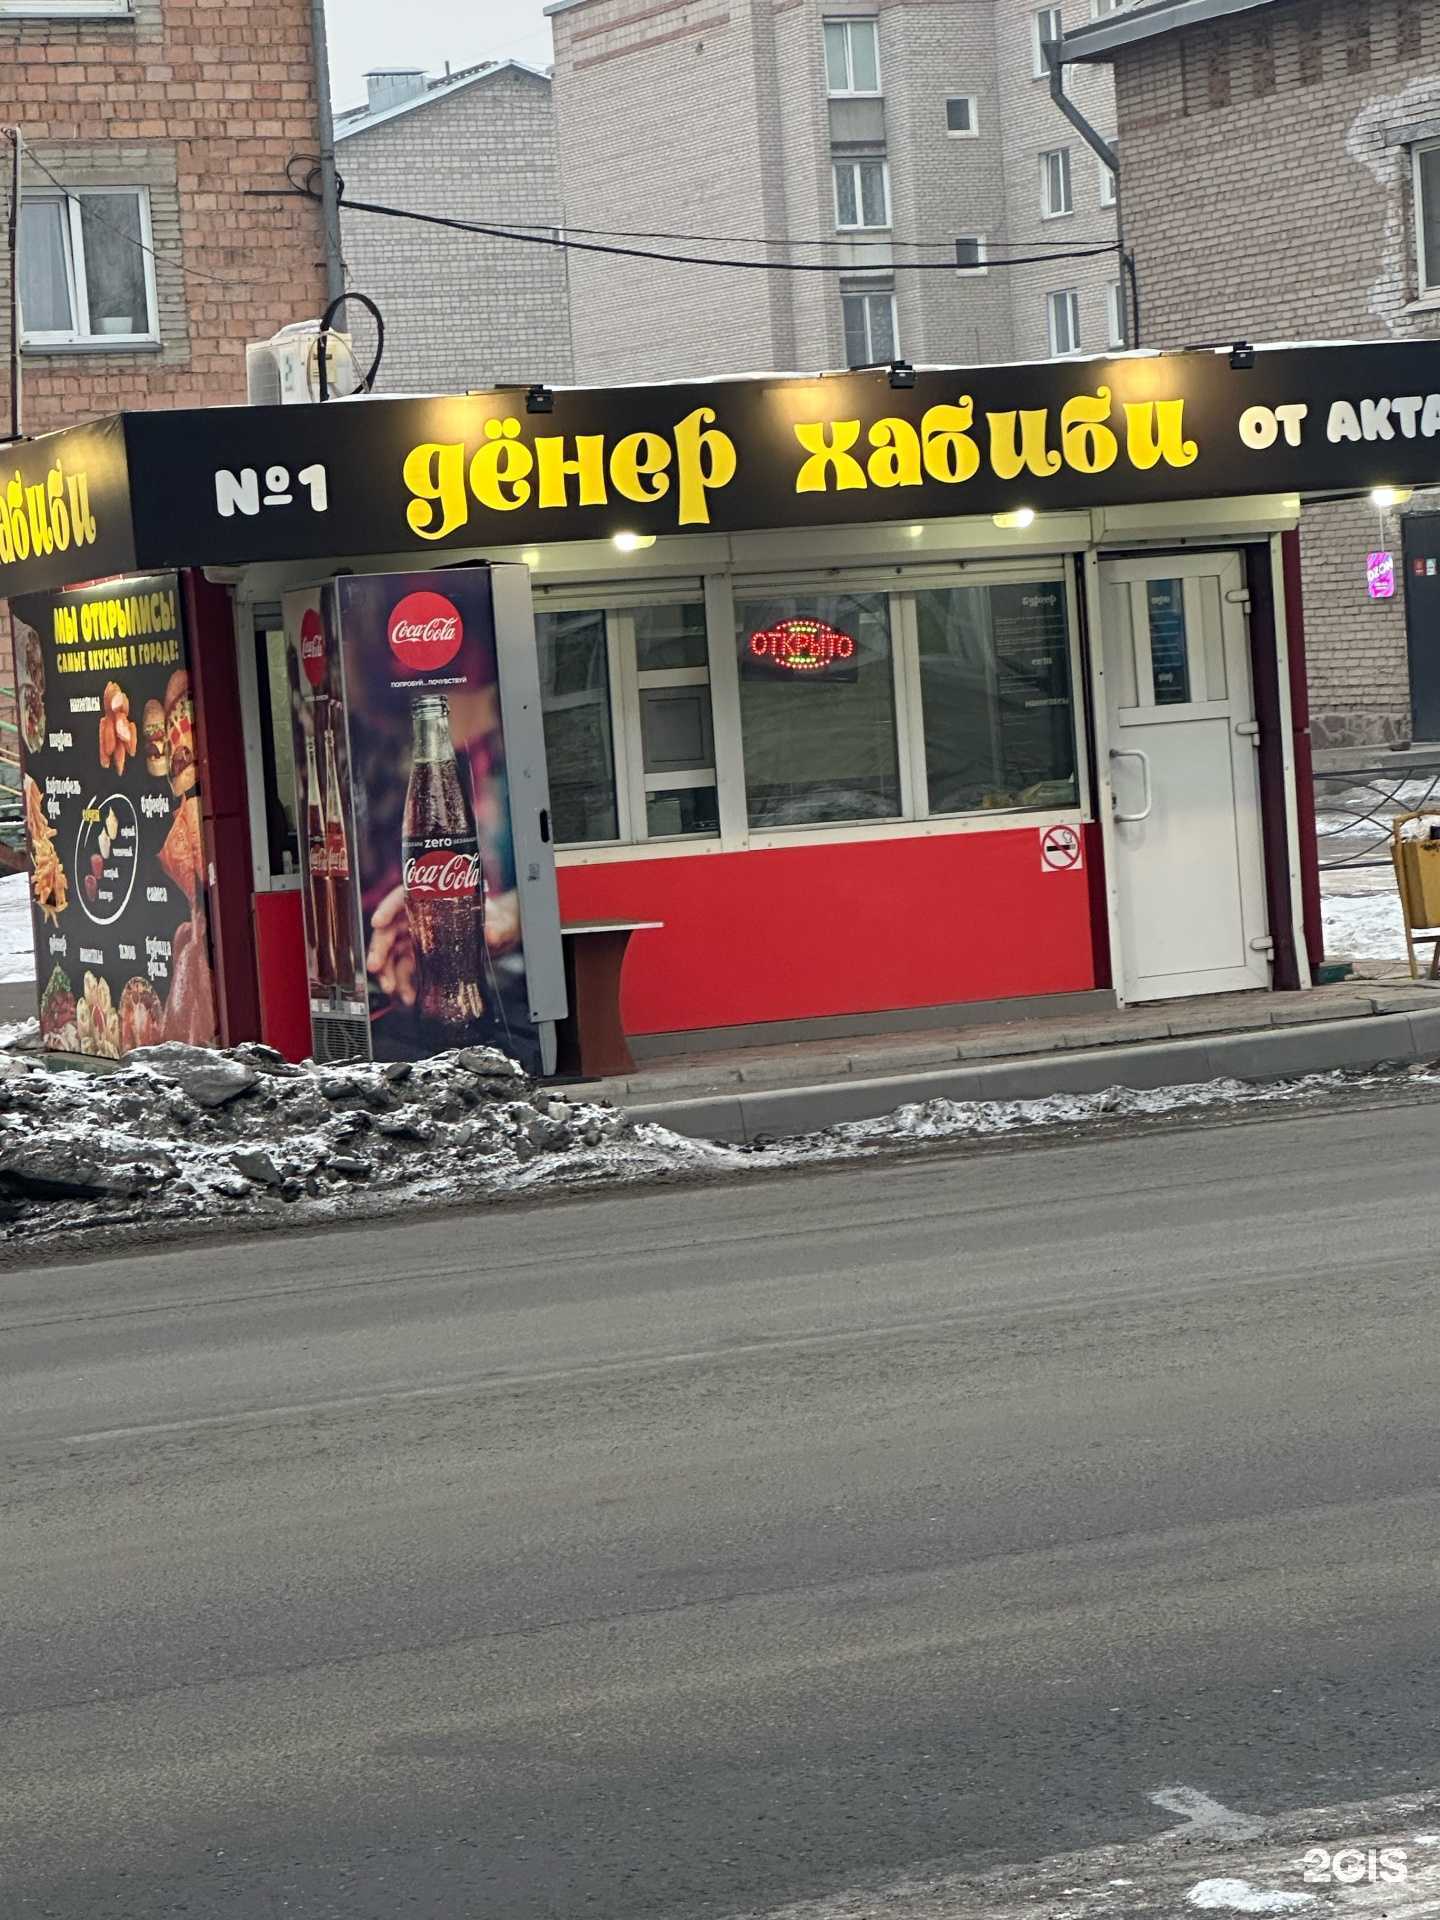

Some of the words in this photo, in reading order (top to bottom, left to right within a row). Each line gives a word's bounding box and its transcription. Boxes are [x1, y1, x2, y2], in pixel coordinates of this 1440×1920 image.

[403, 406, 737, 540] дёнер
[793, 385, 1198, 494] хабиби
[53, 605, 79, 645] МЫ
[80, 590, 177, 642] ОТКРЫЛИСЬ!
[391, 617, 458, 643] Coca-Cola
[750, 632, 855, 660] ОТКРЫТО
[424, 837, 452, 849] zero
[402, 850, 480, 892] Coca-Cola
